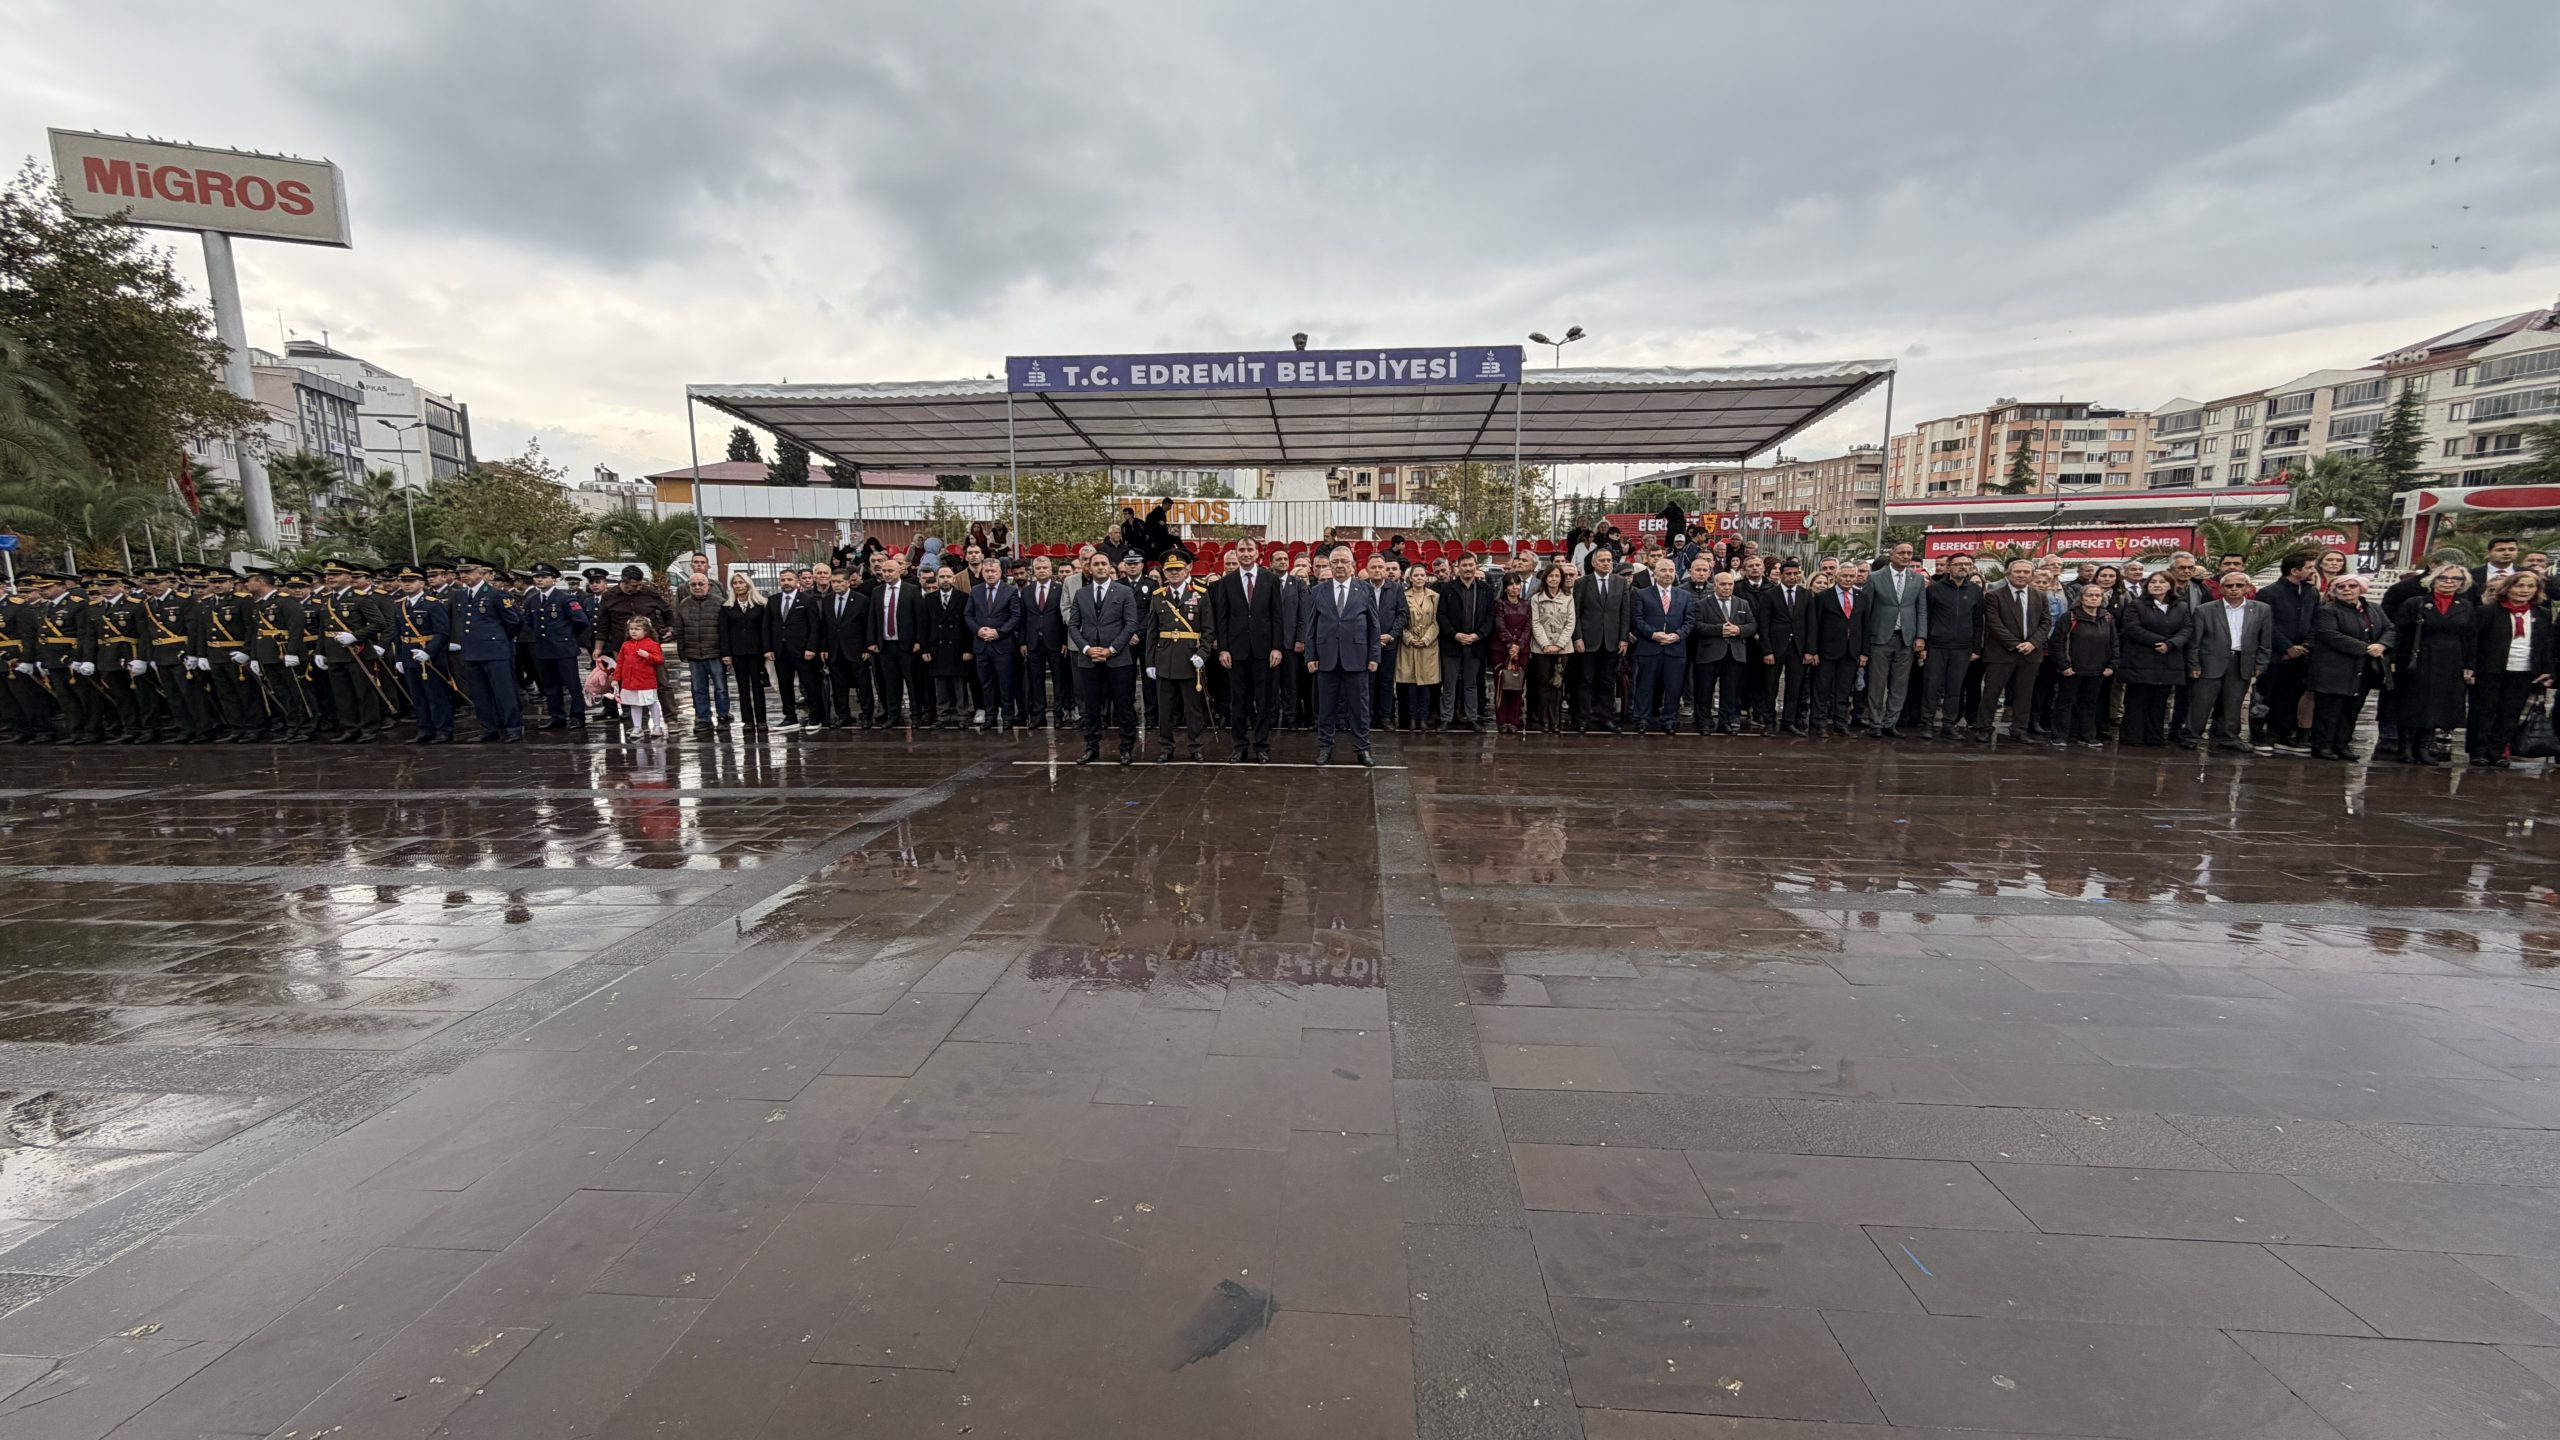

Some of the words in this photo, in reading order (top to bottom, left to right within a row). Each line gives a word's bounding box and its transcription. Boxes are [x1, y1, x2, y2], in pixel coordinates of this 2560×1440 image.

[1063, 366, 1119, 386] T.C.
[1131, 356, 1265, 385] EDREMİT
[1277, 351, 1457, 382] BELEDİYESİ
[1932, 542, 1982, 551] BEREKET
[2057, 539, 2113, 549] BEREKET
[2129, 536, 2180, 548] DÖNER
